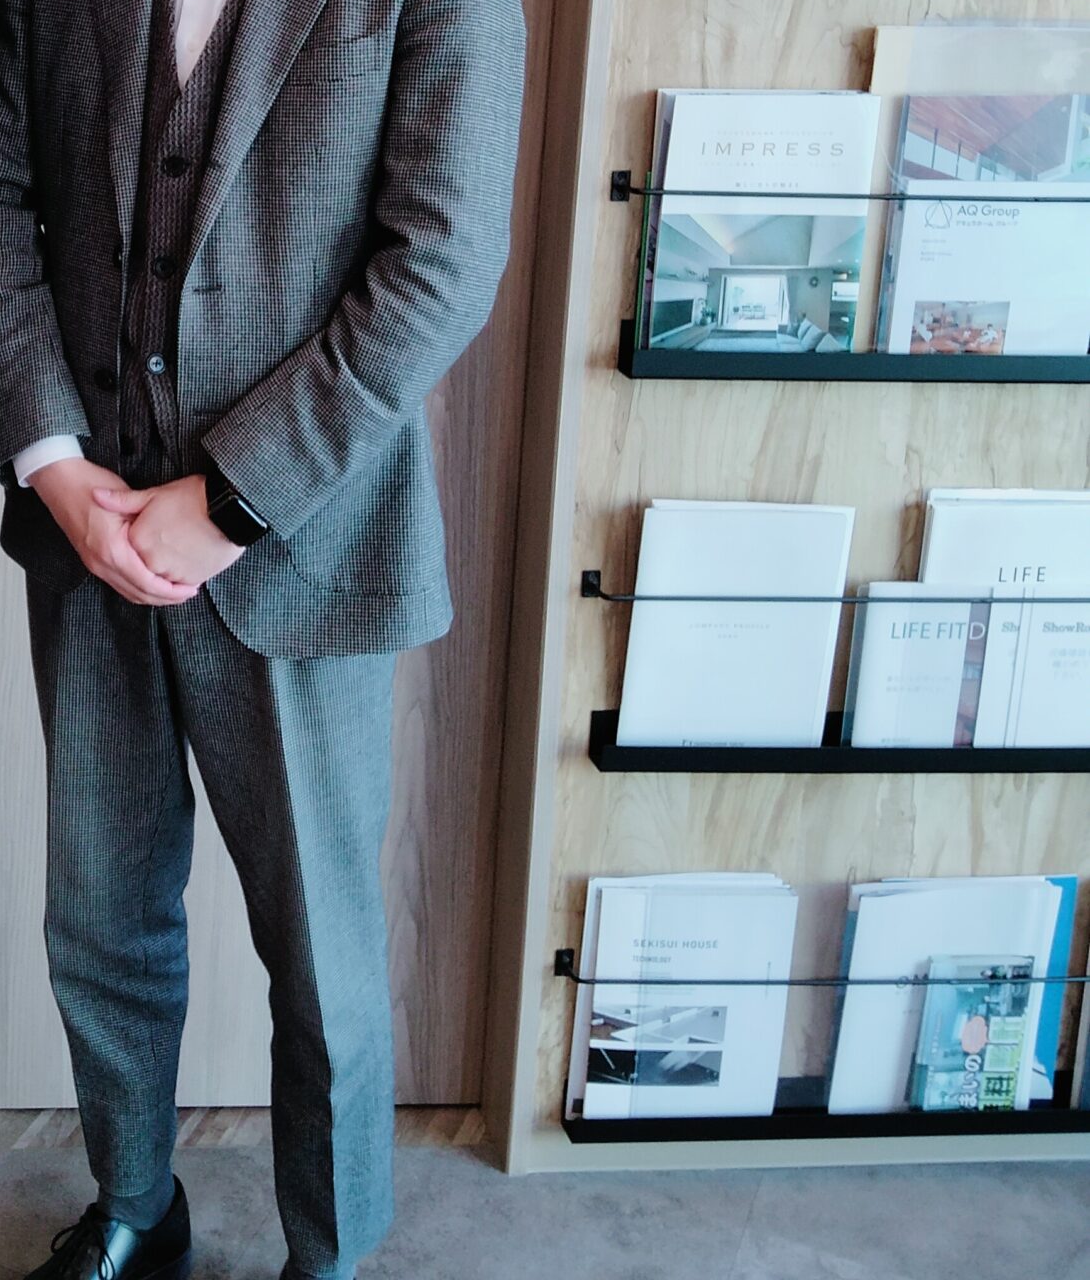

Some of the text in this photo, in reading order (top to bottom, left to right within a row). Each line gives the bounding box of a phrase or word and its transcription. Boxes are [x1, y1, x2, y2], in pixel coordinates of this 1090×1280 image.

[701, 141, 845, 157] IMPRESS
[957, 204, 1020, 219] AQ Group
[998, 566, 1047, 583] LIFE
[890, 622, 966, 640] LIFE FIT
[632, 938, 719, 949] SEKISUI HOUSE
